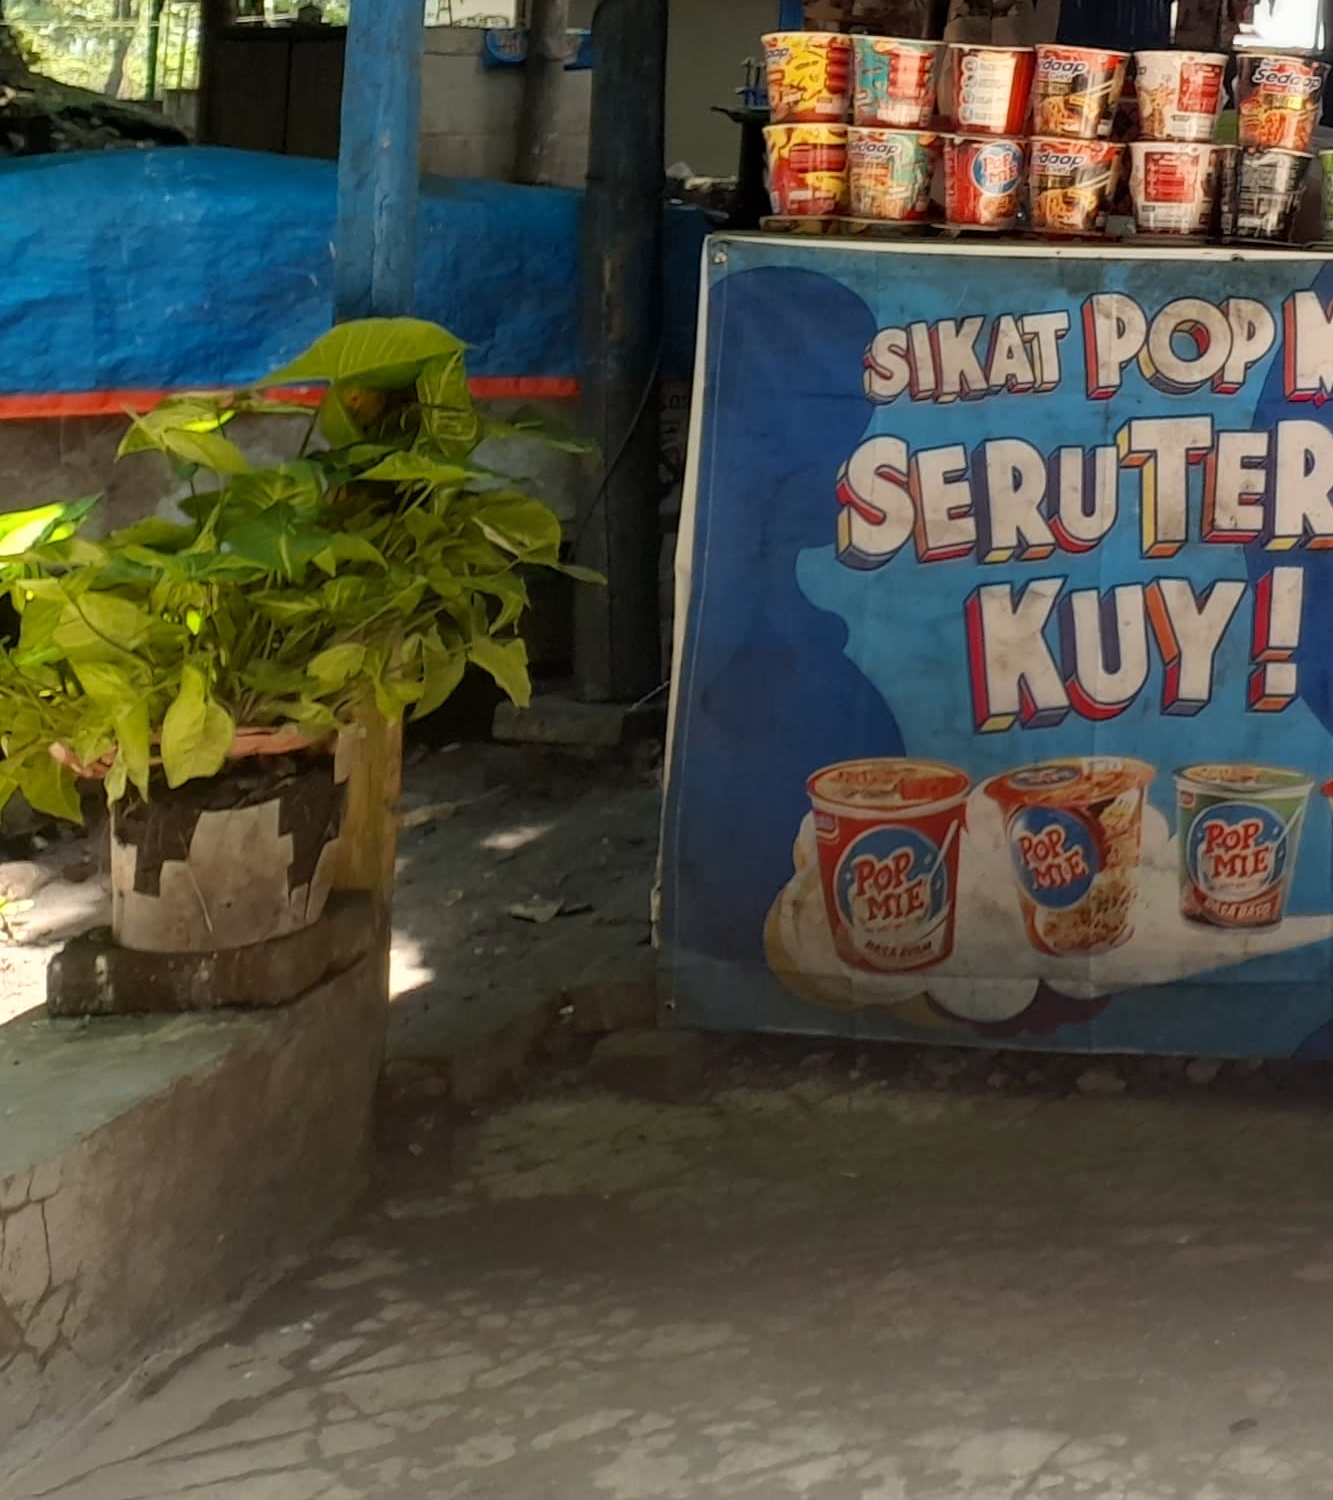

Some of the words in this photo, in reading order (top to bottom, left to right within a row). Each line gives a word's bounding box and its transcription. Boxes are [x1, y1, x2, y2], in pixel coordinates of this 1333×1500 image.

[863, 309, 1071, 404] SIKAT
[1080, 292, 1277, 401] POP
[964, 566, 1305, 734] KUY!
[1018, 826, 1065, 866] POP
[1203, 821, 1263, 850] POP
[853, 847, 914, 897] POP
[1033, 849, 1089, 891] MIE
[1211, 845, 1272, 879] MIE
[867, 879, 927, 922] MIE
